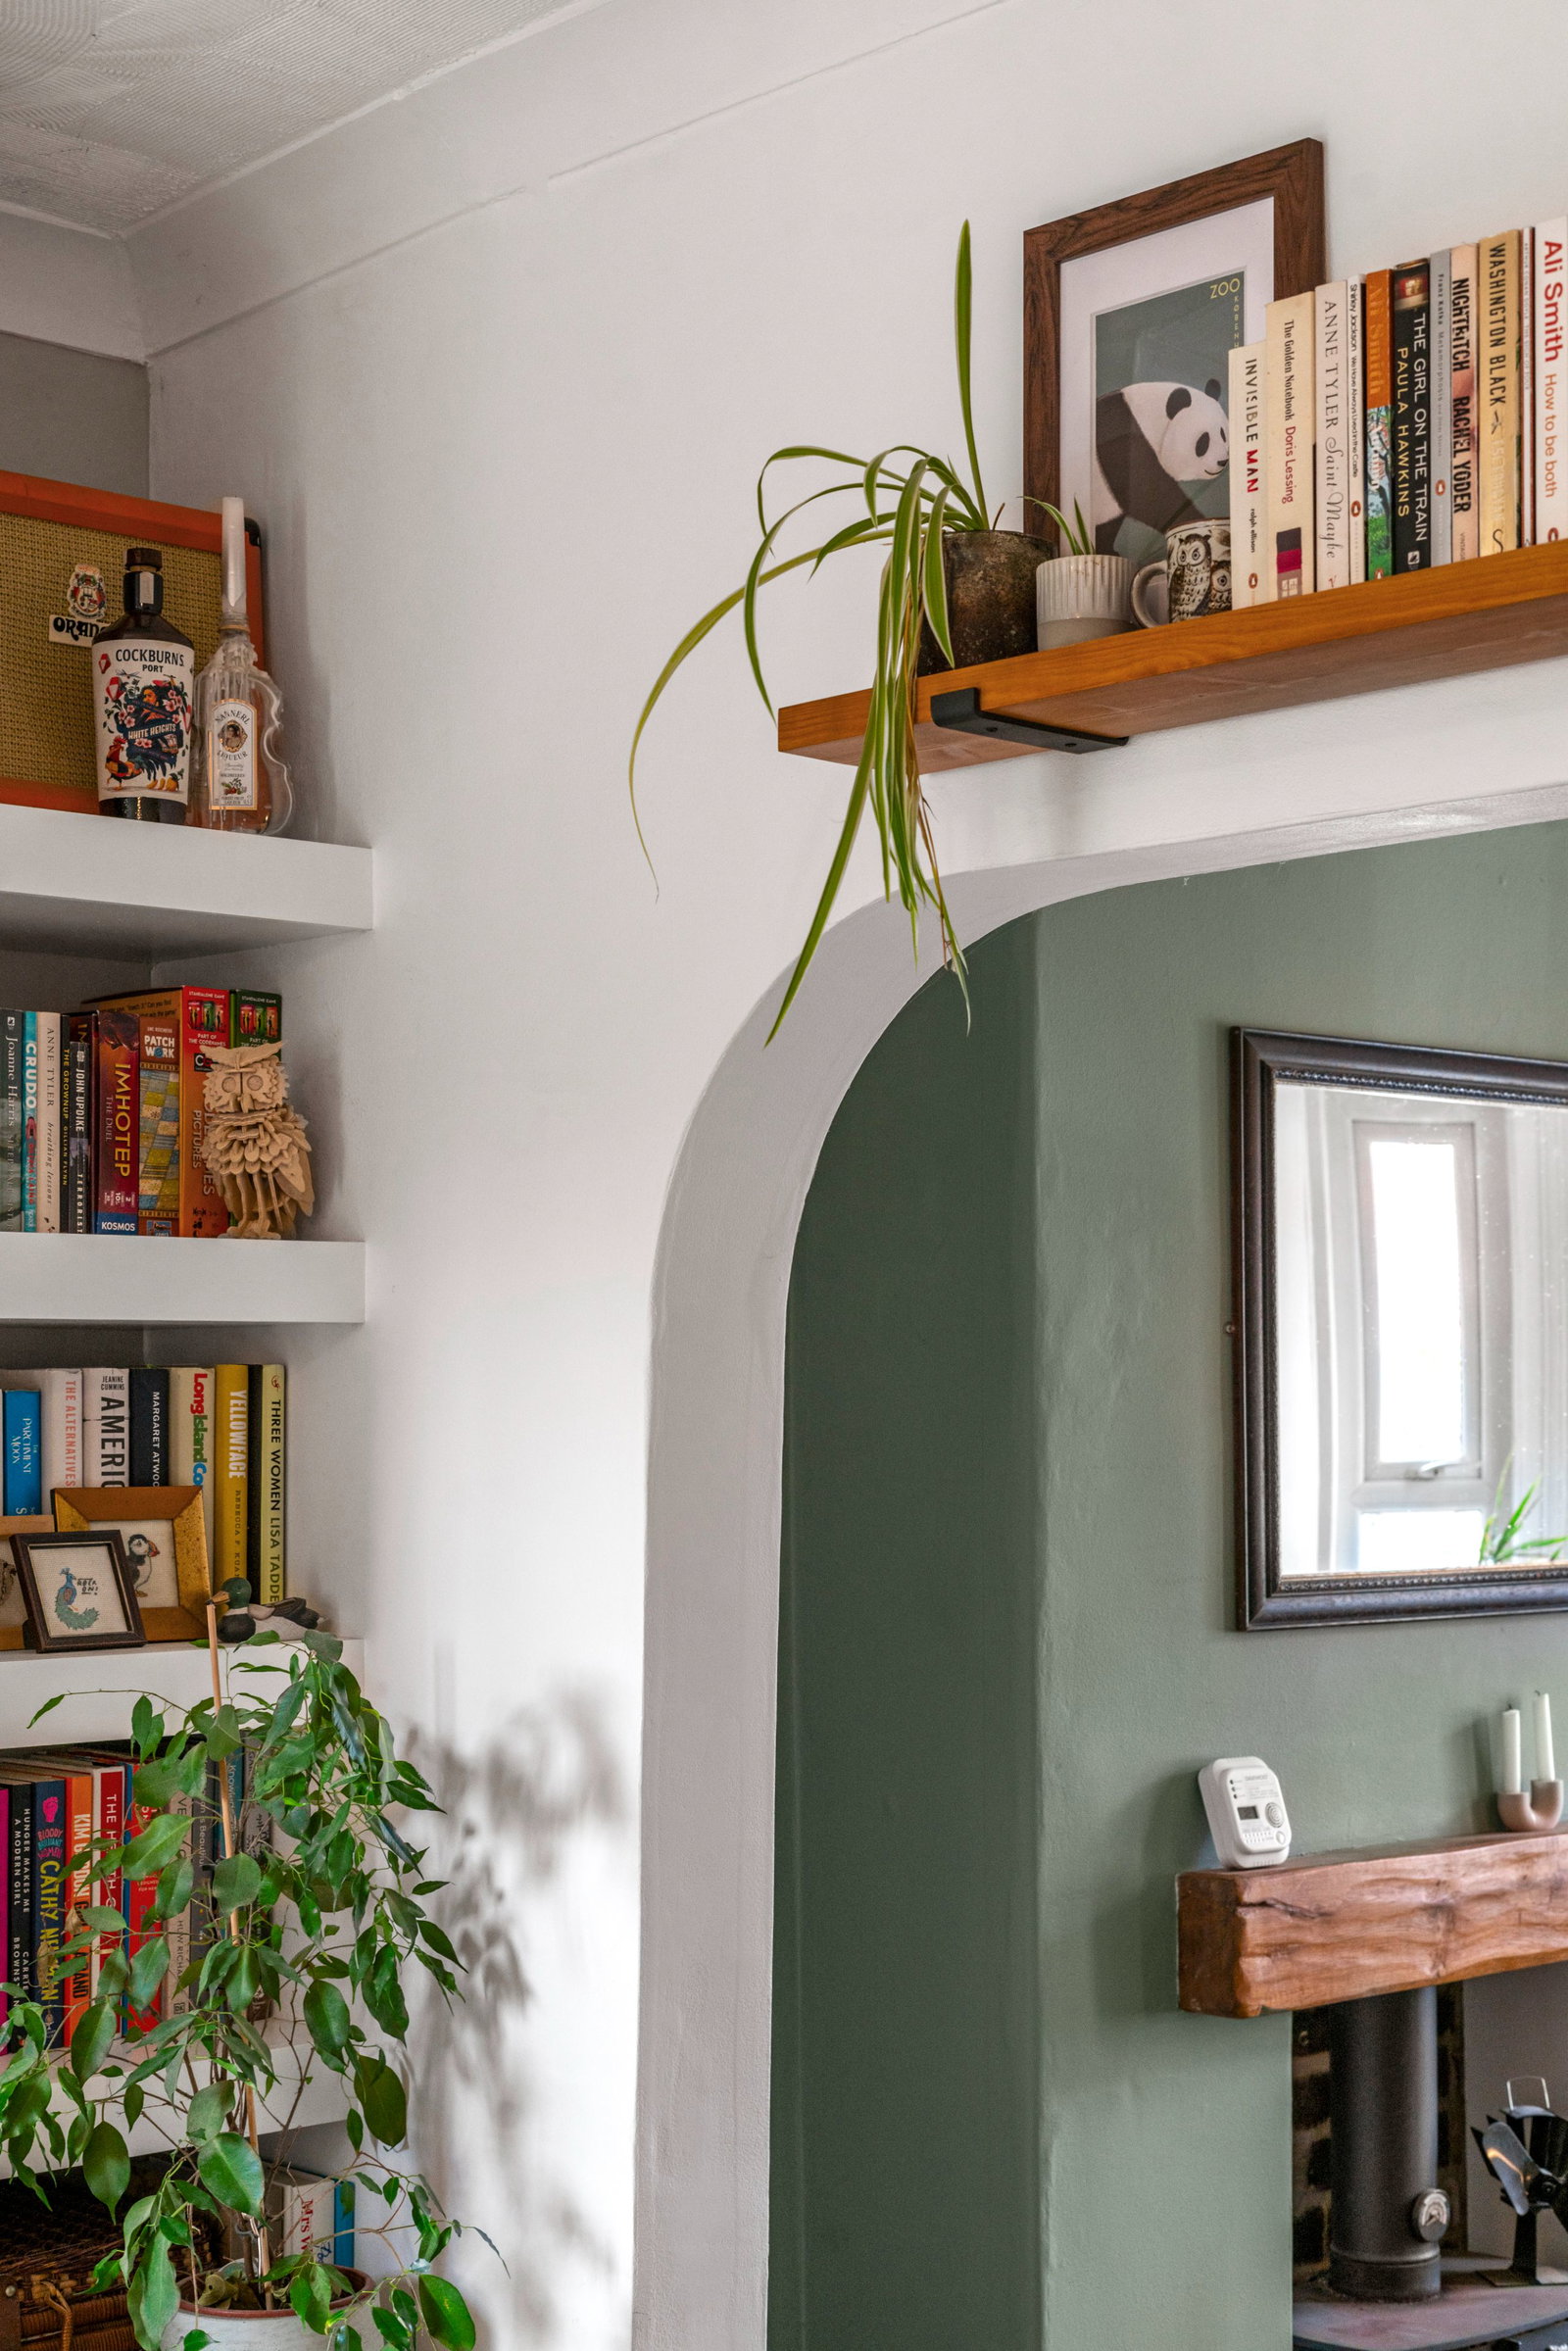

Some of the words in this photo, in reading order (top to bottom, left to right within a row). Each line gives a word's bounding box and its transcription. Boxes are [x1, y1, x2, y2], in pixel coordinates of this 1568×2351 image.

[1544, 240, 1563, 274] Ali
[1210, 278, 1240, 299] ZOO
[1490, 242, 1506, 348] WASHINGTON
[1284, 318, 1295, 338] The
[1325, 301, 1338, 358] ANNE
[1413, 313, 1426, 352] THE
[1452, 277, 1470, 373] NIGHTBITCH
[1544, 281, 1563, 363] Smith
[1284, 339, 1295, 373] Golden
[1369, 323, 1385, 395] Smith
[1246, 359, 1258, 443] INVISIBLE
[1284, 375, 1295, 421] Notebook
[1325, 363, 1339, 429] TYLER
[1397, 347, 1409, 414] PAULA
[1414, 358, 1426, 403] GIRL
[1490, 354, 1506, 406] BLACK
[1544, 373, 1557, 410] How
[1285, 426, 1298, 457] Doris
[1414, 408, 1427, 436] ON
[1452, 395, 1470, 459] RACHEL
[1544, 414, 1557, 431] to
[1325, 436, 1344, 487] Saint
[1414, 441, 1427, 480] THE
[1544, 435, 1557, 457] be
[1247, 449, 1259, 493] MAN
[1281, 459, 1298, 505] Lessing
[1397, 424, 1409, 517] HAWKINS
[1453, 461, 1471, 514] YODER
[1544, 460, 1557, 498] both
[1249, 509, 1257, 528] ralph
[1319, 492, 1344, 559] Maybe
[1414, 483, 1427, 542] TRAIN
[142, 664, 164, 673] PORT
[128, 728, 149, 740] WHITE
[150, 723, 176, 736] HEIGHTS
[217, 750, 248, 761] LIQUEUR
[6, 1035, 19, 1080] Joanne
[46, 1026, 55, 1061] ANNE
[144, 1035, 174, 1048] PATCH
[25, 1043, 37, 1109] CRUDO
[46, 1067, 55, 1106] TYLER
[75, 1069, 85, 1094] JOHN
[7, 1085, 18, 1127] Harris
[75, 1096, 85, 1133] UPDIKE
[115, 1063, 131, 1177] IMHOTEP
[45, 1121, 54, 1166] breathing
[193, 1109, 203, 1169] PICTURES
[101, 1221, 135, 1232] KOSMOS
[66, 1380, 76, 1401] THE
[102, 1375, 123, 1384] JEANINE
[190, 1373, 208, 1415] Long
[152, 1392, 161, 1448] MARGARET
[193, 1415, 208, 1463] Island
[228, 1390, 247, 1479] YELLOWFACE
[270, 1399, 282, 1444] THREE
[66, 1405, 76, 1487] ALTERNATIVES
[270, 1449, 281, 1511] WOMEN
[270, 1517, 281, 1549] LISA
[270, 1554, 280, 1602] TADDE
[74, 1813, 91, 1840] KIM
[106, 1793, 118, 1824] THE
[38, 1828, 64, 1841] BLOODY
[40, 1860, 62, 1921] CATHY
[74, 1842, 91, 1897] GDON
[24, 1898, 31, 1913] ME
[40, 1928, 61, 2000] NEN
[73, 1962, 89, 1999] AND
[301, 2198, 314, 2232] Mrs
